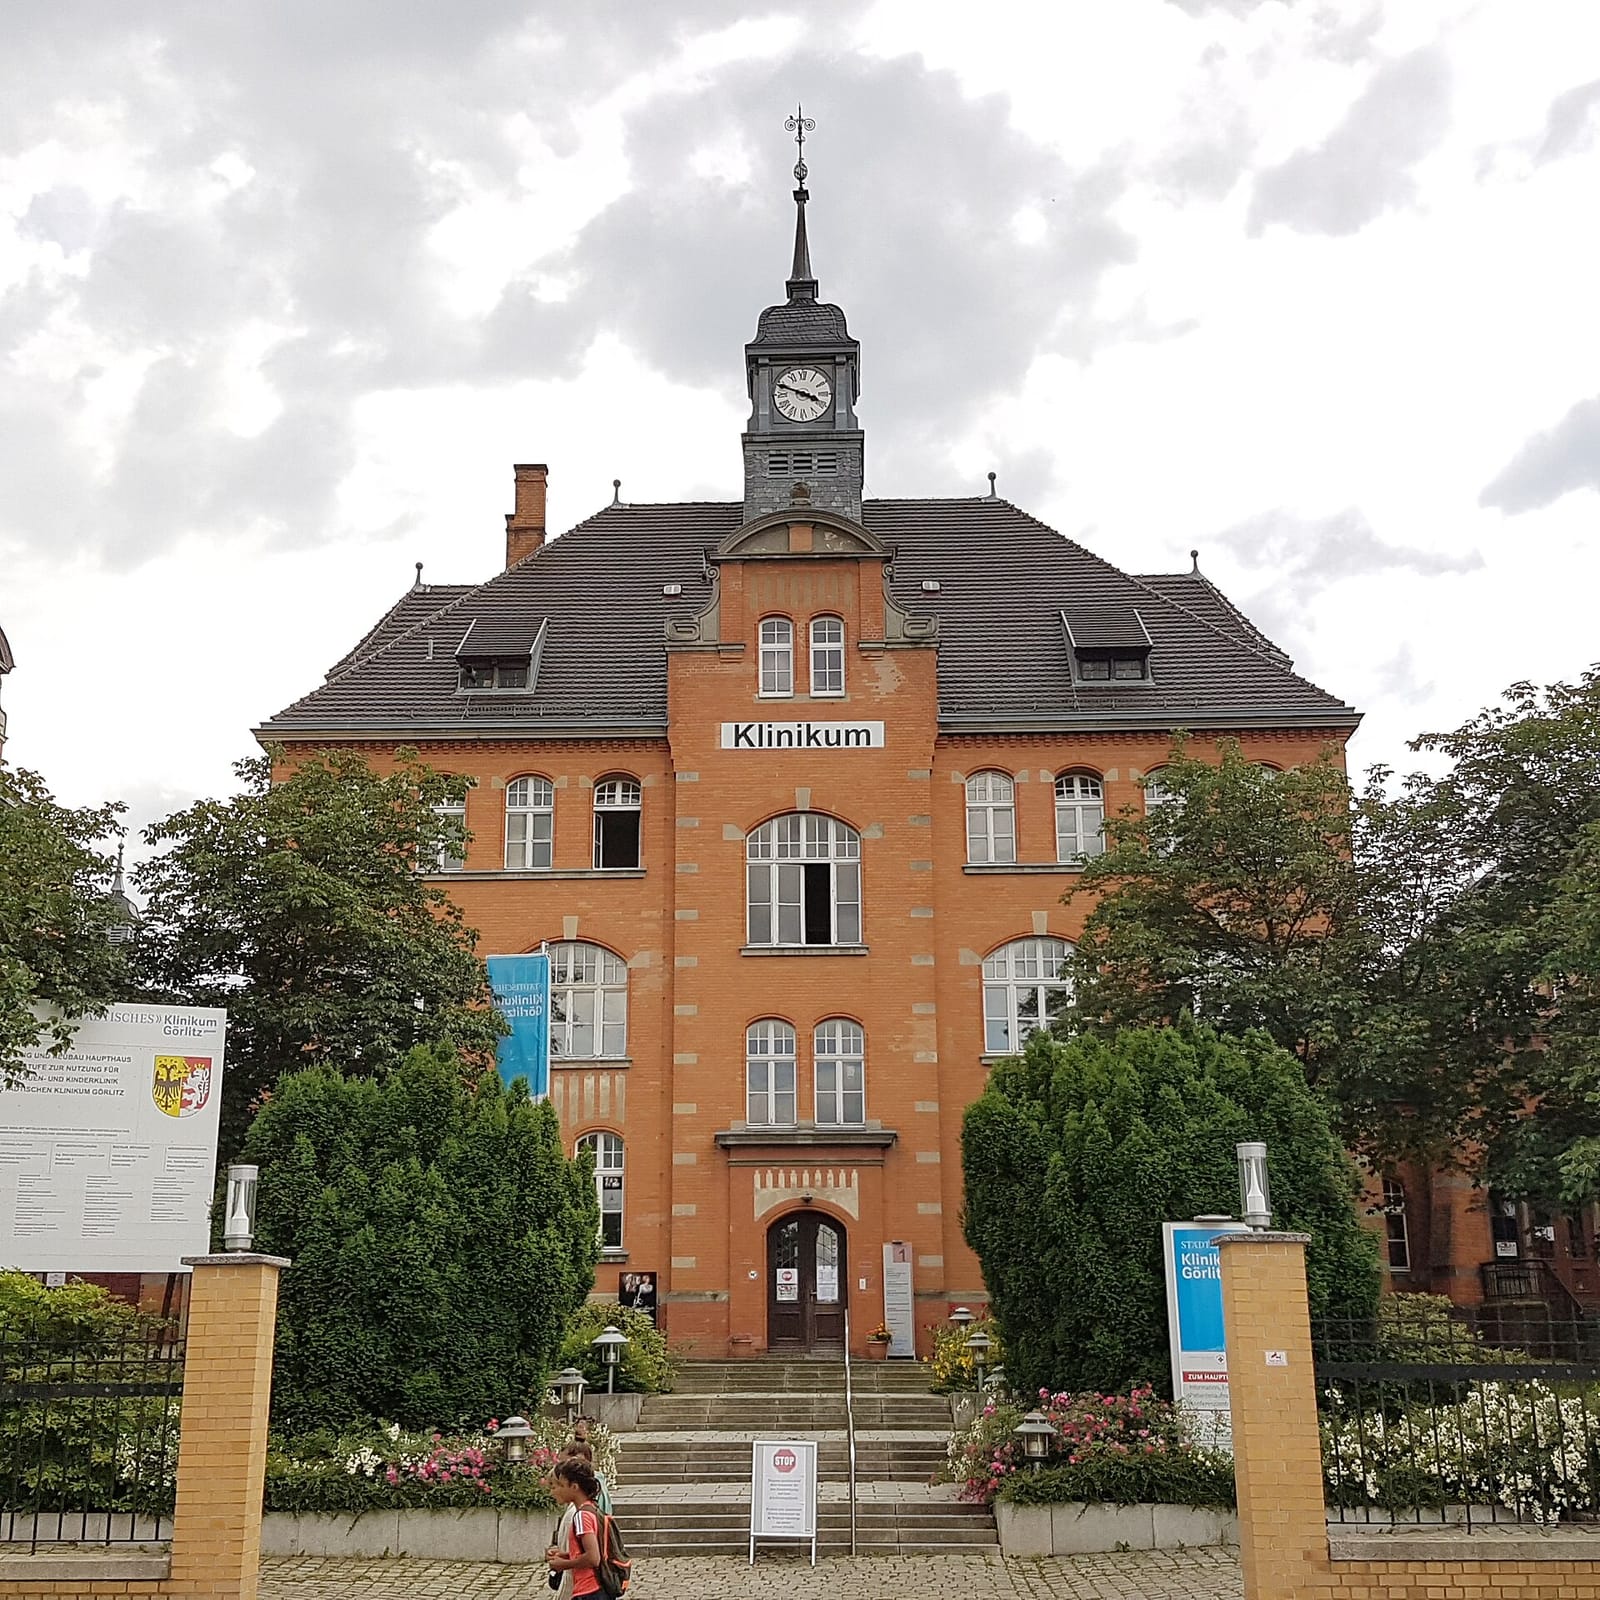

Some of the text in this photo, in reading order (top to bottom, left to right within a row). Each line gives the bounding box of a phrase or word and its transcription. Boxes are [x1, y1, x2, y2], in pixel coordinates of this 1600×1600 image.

[734, 723, 871, 748] Klinikum
[164, 1014, 217, 1027] Klinikum
[163, 1025, 203, 1037] Görlitz
[85, 1055, 132, 1063] HAUPTHAUS
[66, 1065, 102, 1073] NUTZUNG
[103, 1065, 119, 1073] FÜR
[48, 1075, 64, 1083] UND
[66, 1076, 119, 1085] KINDERKLINIK
[54, 1086, 91, 1095] KLINIKUM
[92, 1088, 125, 1096] GÖRLITZ
[1181, 1253, 1220, 1266] Klinik
[1182, 1266, 1221, 1279] Görlit
[774, 1456, 795, 1466] STOP
